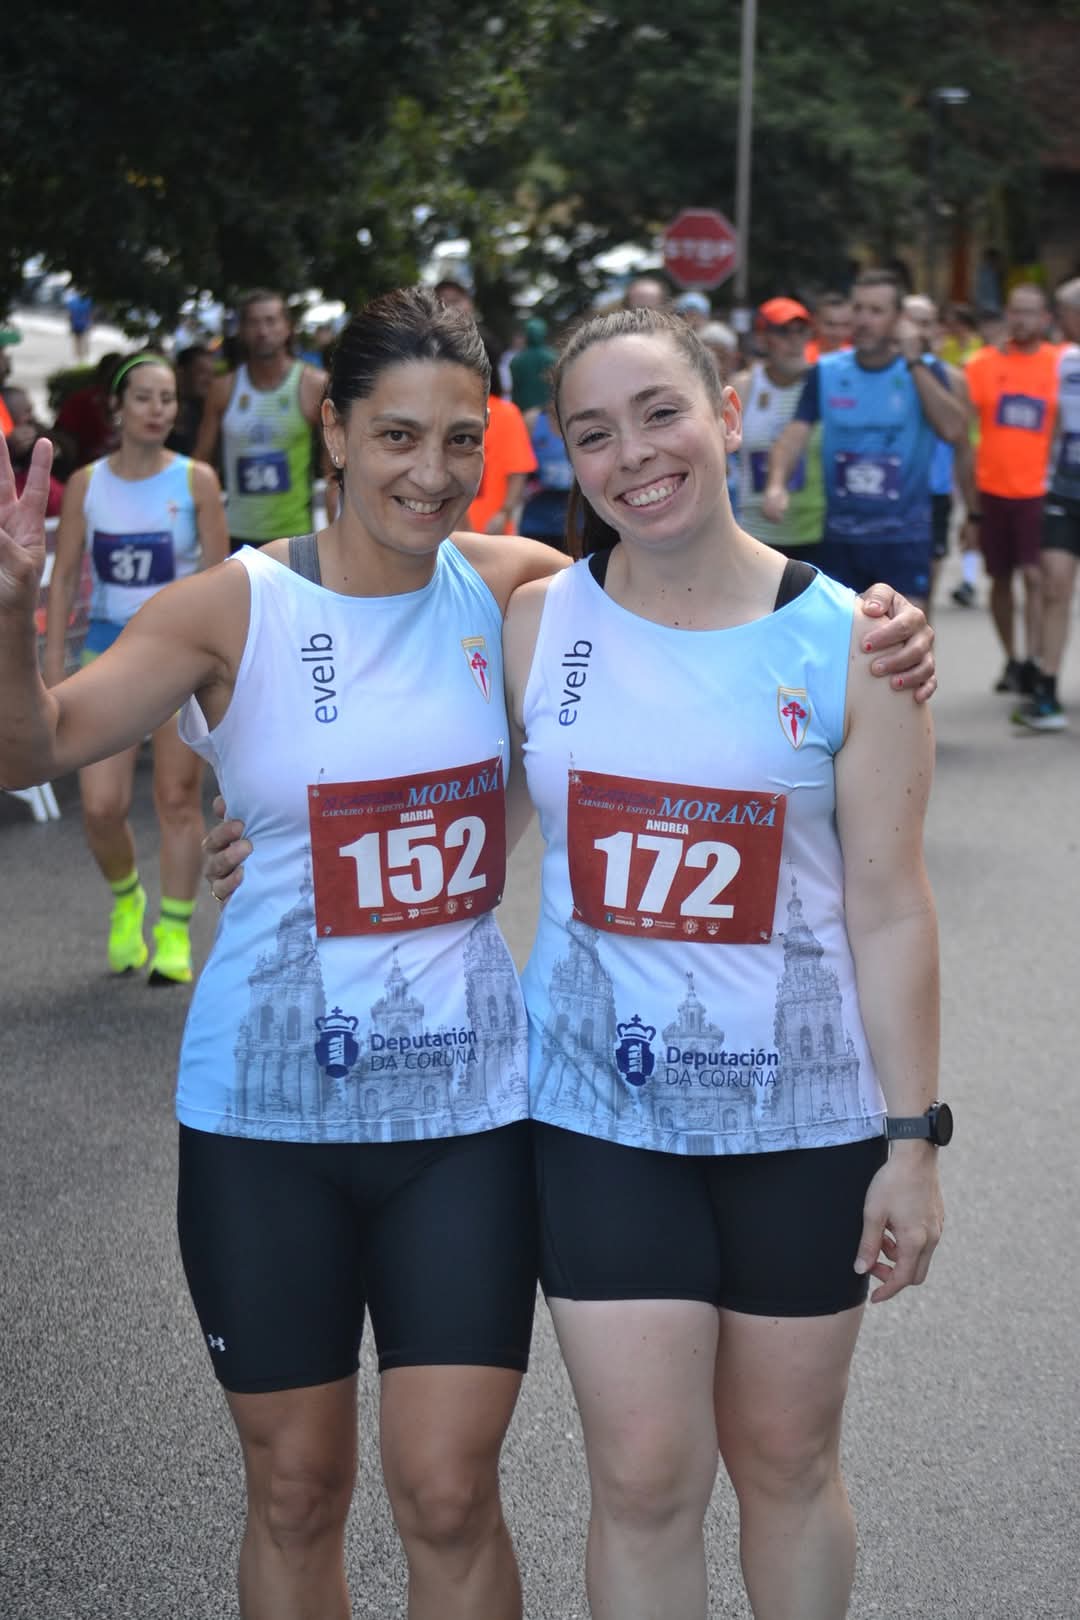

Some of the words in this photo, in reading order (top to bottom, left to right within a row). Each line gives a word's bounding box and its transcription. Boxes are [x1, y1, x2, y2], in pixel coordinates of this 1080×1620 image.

[664, 238, 735, 264] STOP
[110, 549, 153, 581] 37
[301, 632, 338, 724] evelb
[558, 639, 593, 726] evelb
[400, 809, 434, 824] MARIA
[658, 796, 776, 827] MORAÑA
[646, 819, 689, 835] ANDREA
[339, 816, 487, 909] 152
[594, 831, 741, 919] 172
[370, 1027, 478, 1054] Deputación
[371, 1055, 399, 1072] DA
[405, 1046, 479, 1070] CORUÑA
[666, 1046, 779, 1070] Deputación
[666, 1068, 693, 1087] DA
[699, 1067, 777, 1088] CORUÑA
